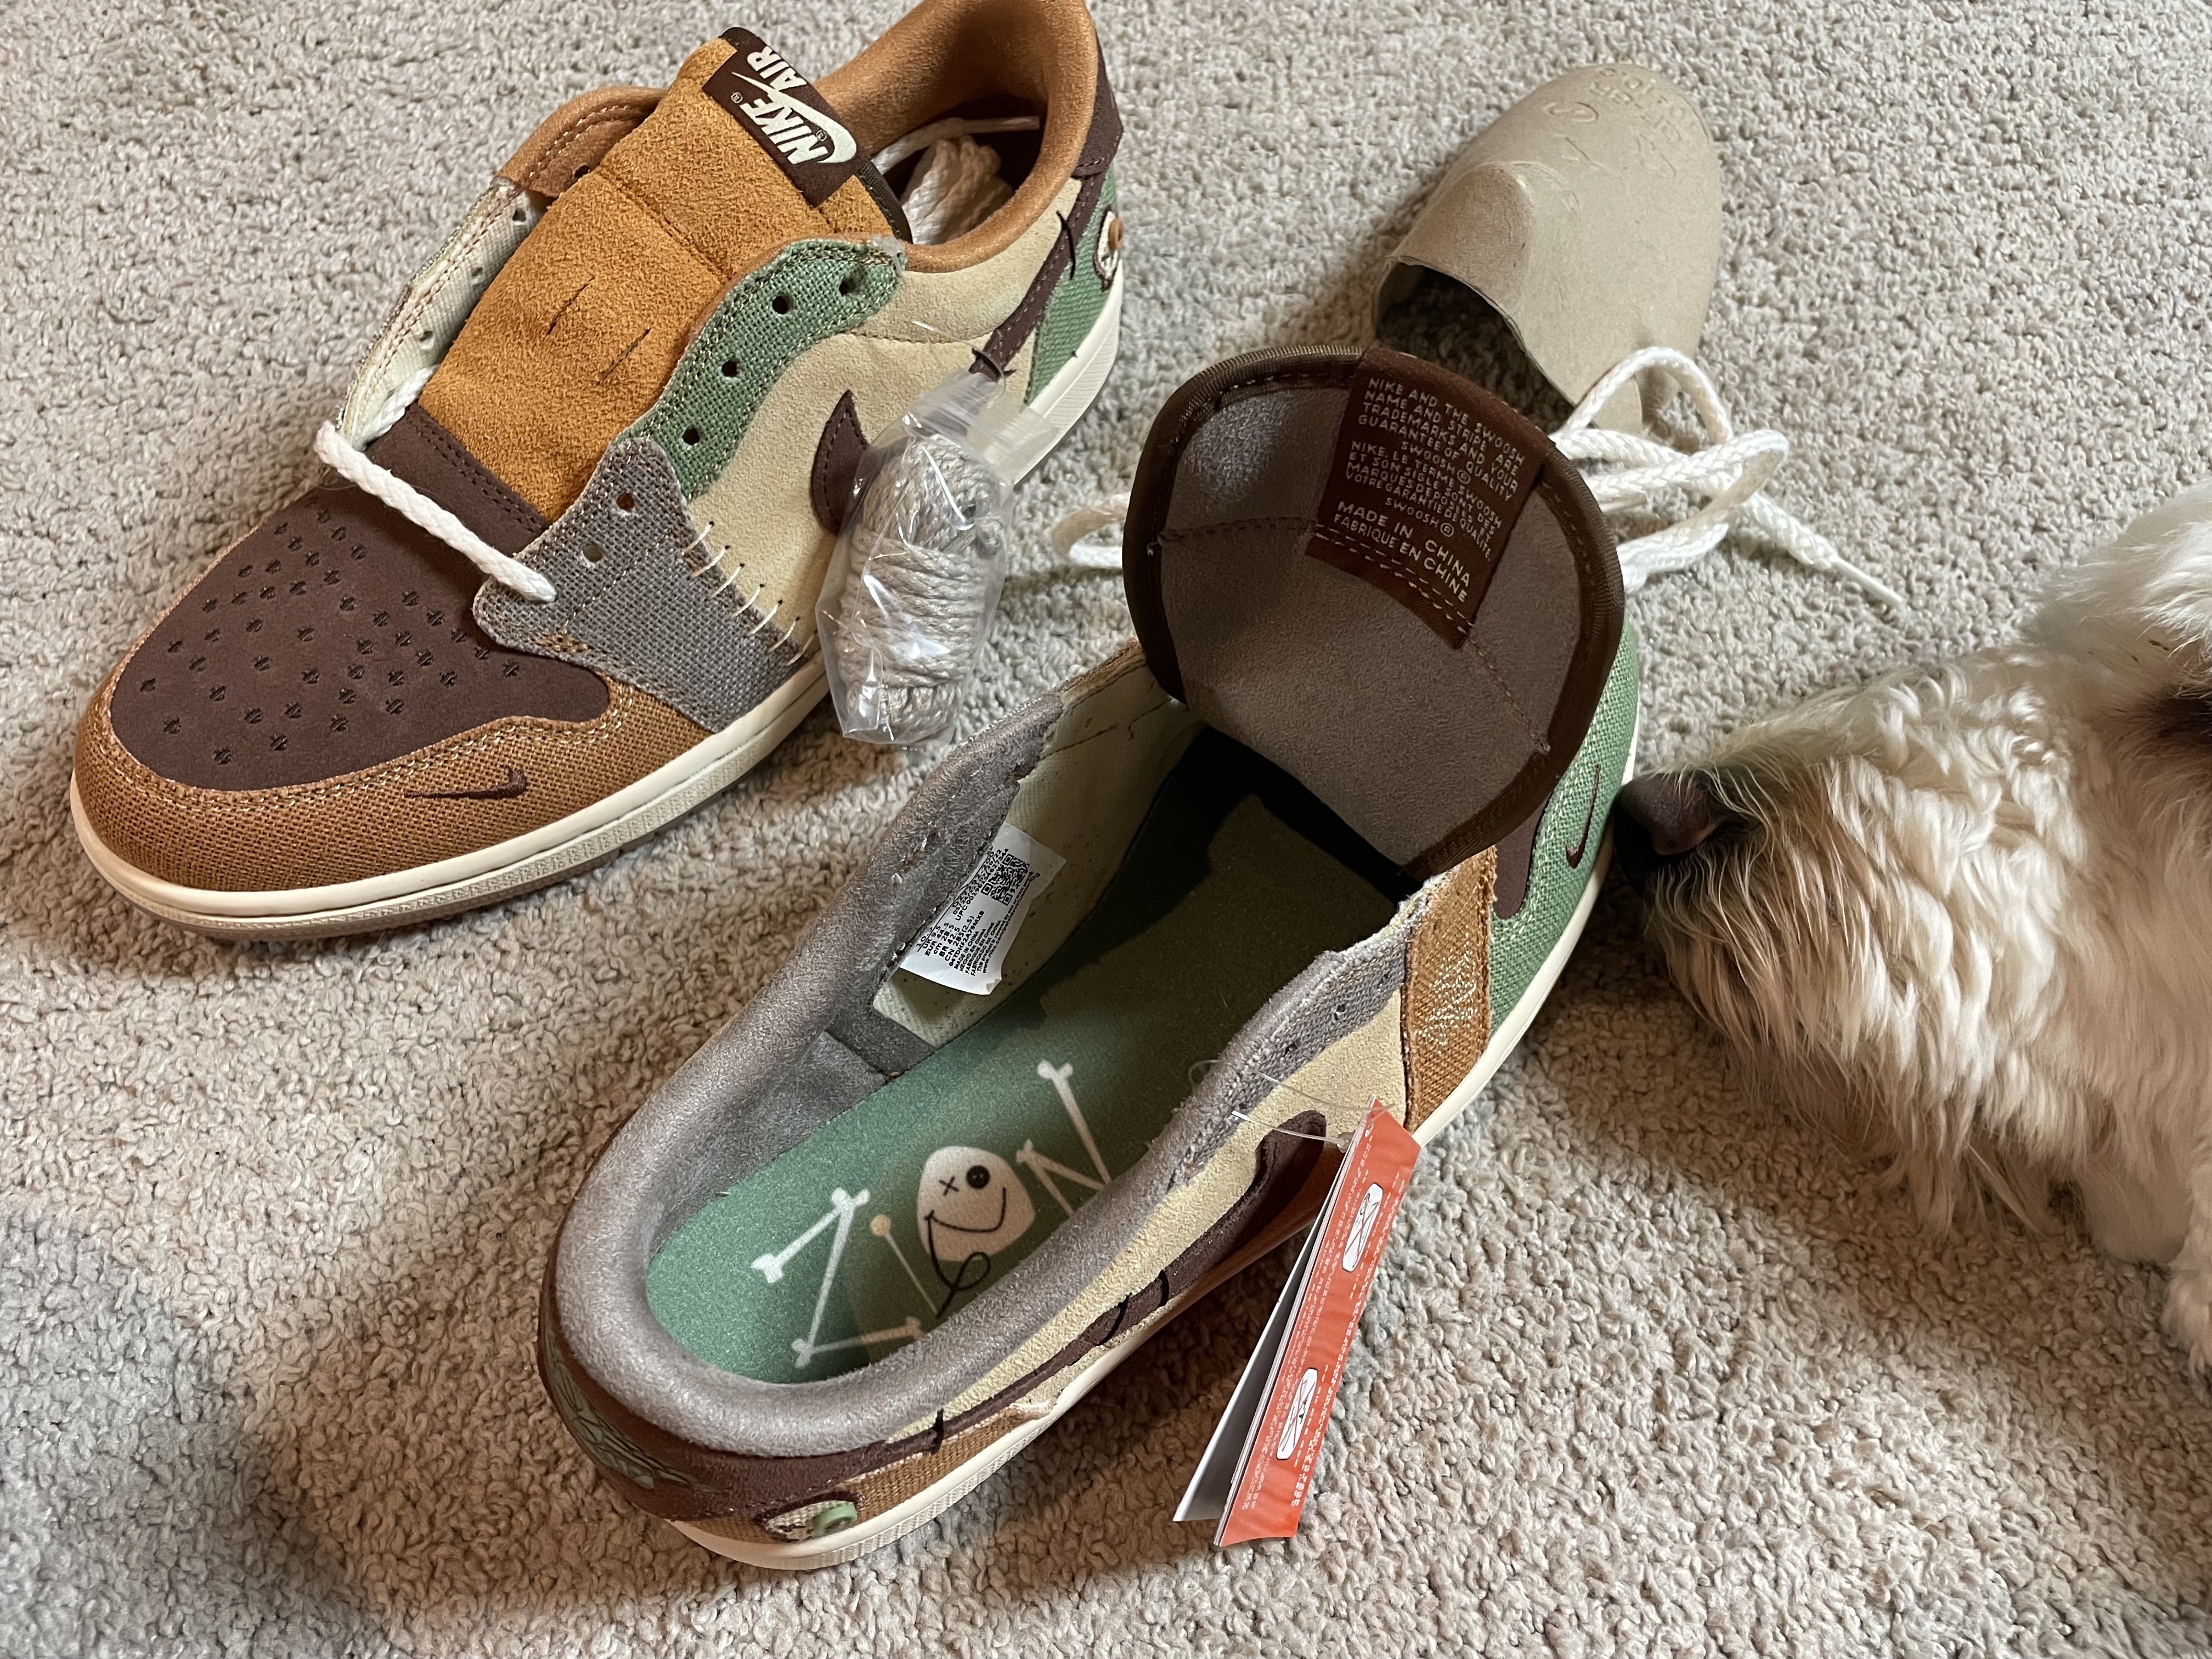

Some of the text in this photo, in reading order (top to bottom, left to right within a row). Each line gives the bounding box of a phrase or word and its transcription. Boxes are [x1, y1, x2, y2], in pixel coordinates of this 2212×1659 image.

[747, 46, 807, 91] AIR
[740, 98, 828, 165] NIKE
[1363, 403, 1517, 493] TRADEMARKS AND YOUR
[1365, 387, 1517, 476] NAME AND STRIPE ARE
[1369, 378, 1524, 465] NIKE AND THE SWOOSH
[1359, 415, 1514, 501] GUARANTEE OF QUALITY
[1346, 467, 1383, 488] VOTRE
[1444, 509, 1457, 521] DE
[1347, 462, 1413, 490] MARQUES
[1479, 526, 1493, 542] ET
[1350, 449, 1498, 534] ET SON SIGLE SONT DES
[1393, 451, 1407, 464] LE
[1416, 460, 1454, 489] TERME
[1458, 486, 1501, 528] SWOOSH
[1334, 514, 1467, 602] FABRIQUE EN CHINE
[1338, 501, 1469, 586] MADE IN CHINA
[922, 924, 941, 949] UK 9.5
[925, 923, 949, 956] EUR 44.5
[934, 924, 954, 954] cm 28.5
[956, 905, 967, 921] UPC
[939, 927, 960, 957] BR 42.5
[945, 949, 955, 961] CN
[954, 953, 965, 969] MADE
[968, 932, 979, 946] CHINA
[960, 953, 971, 972] HECHO
[975, 929, 986, 944] CHINA
[966, 947, 980, 974] FABRIQUE
[971, 944, 986, 976] FABRICADO
[991, 921, 1001, 935] CHINA
